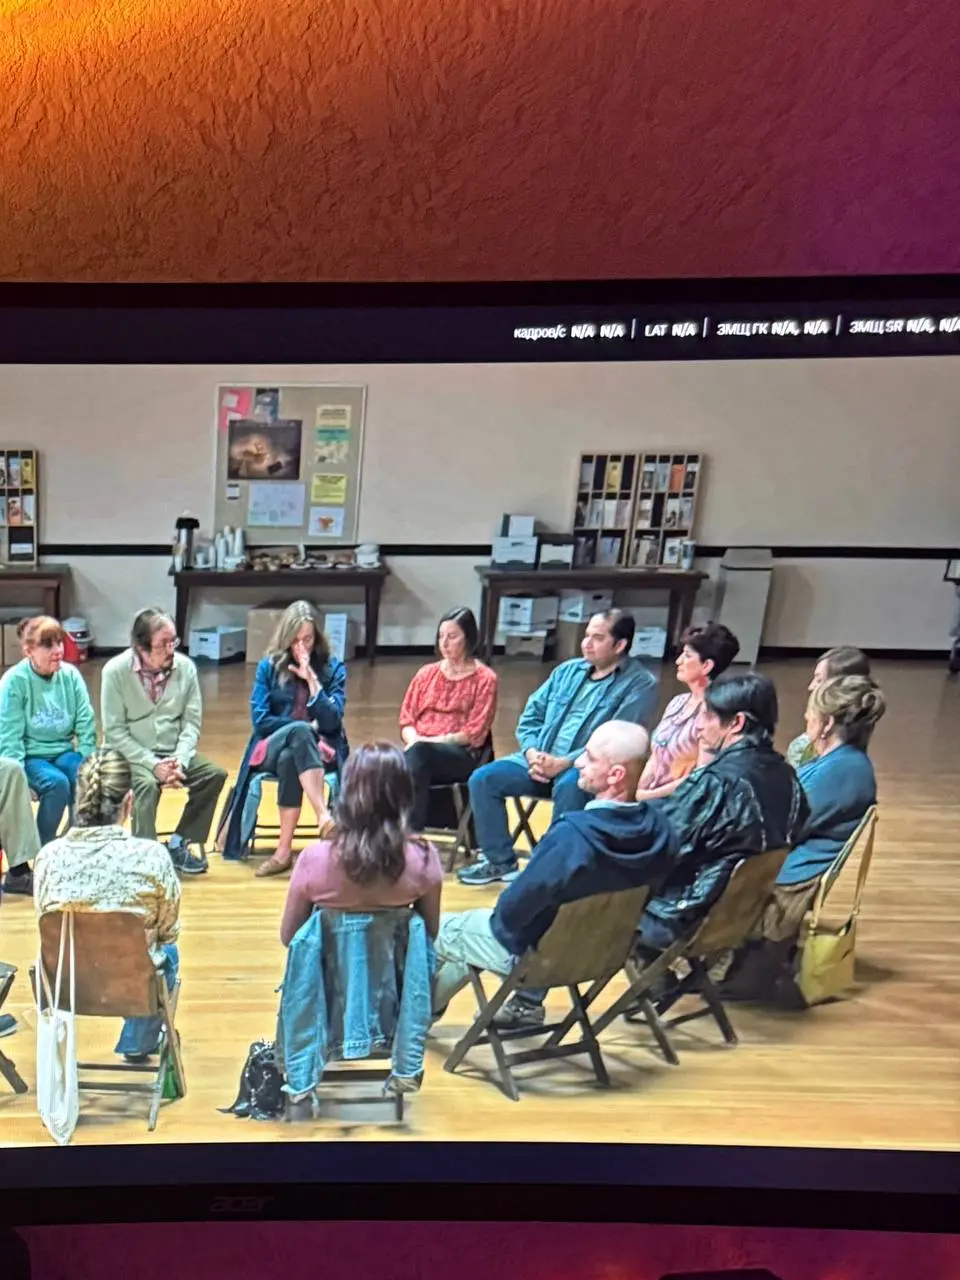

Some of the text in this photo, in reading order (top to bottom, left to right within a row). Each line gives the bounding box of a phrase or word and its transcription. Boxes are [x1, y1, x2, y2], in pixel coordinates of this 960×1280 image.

[571, 323, 595, 339] N/A
[600, 323, 625, 338] N/A
[645, 322, 696, 338] LAT N/A
[803, 319, 830, 335] N/A
